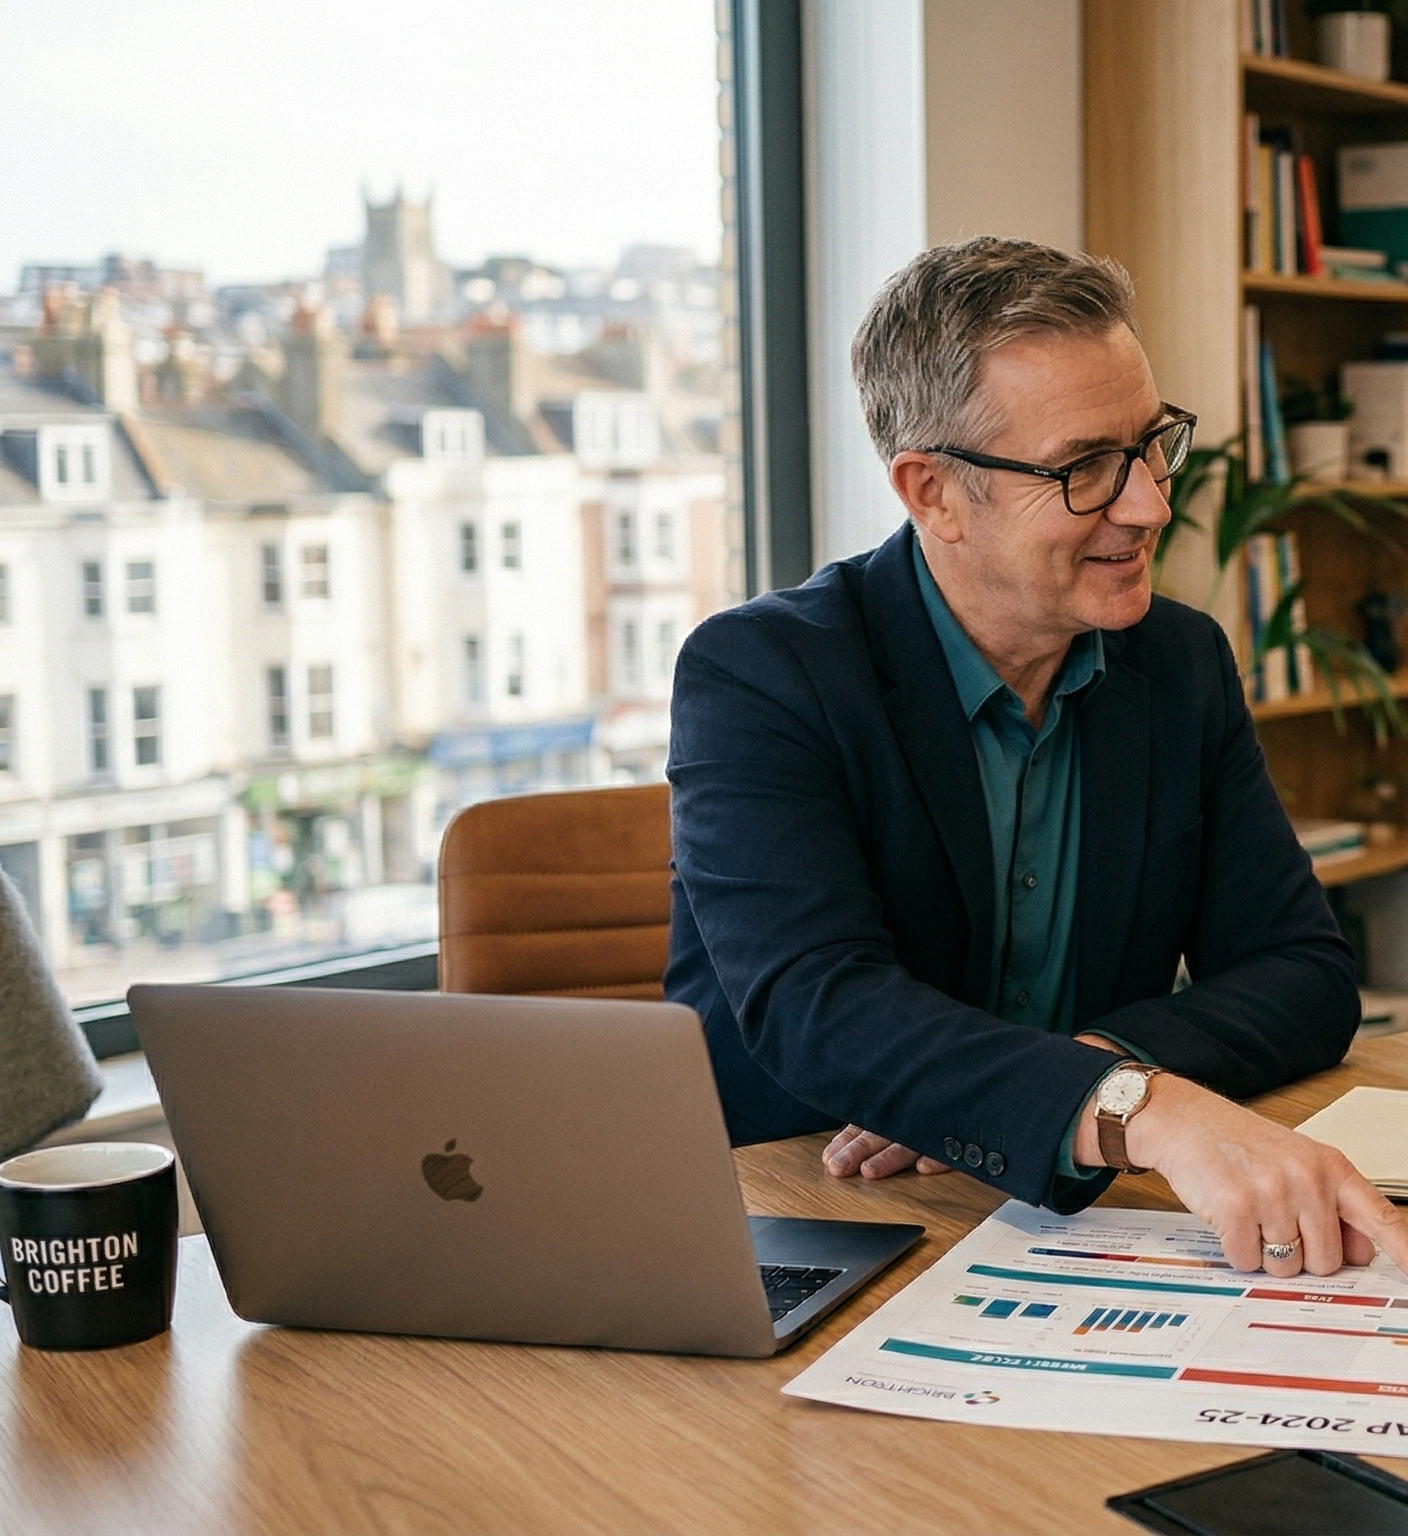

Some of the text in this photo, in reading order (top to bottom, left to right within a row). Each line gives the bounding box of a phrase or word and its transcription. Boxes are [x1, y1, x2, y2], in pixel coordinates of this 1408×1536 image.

[11, 1231, 138, 1264] BRIGHTON
[28, 1265, 124, 1294] COFFEE
[1196, 1408, 1355, 1432] 2024-25
